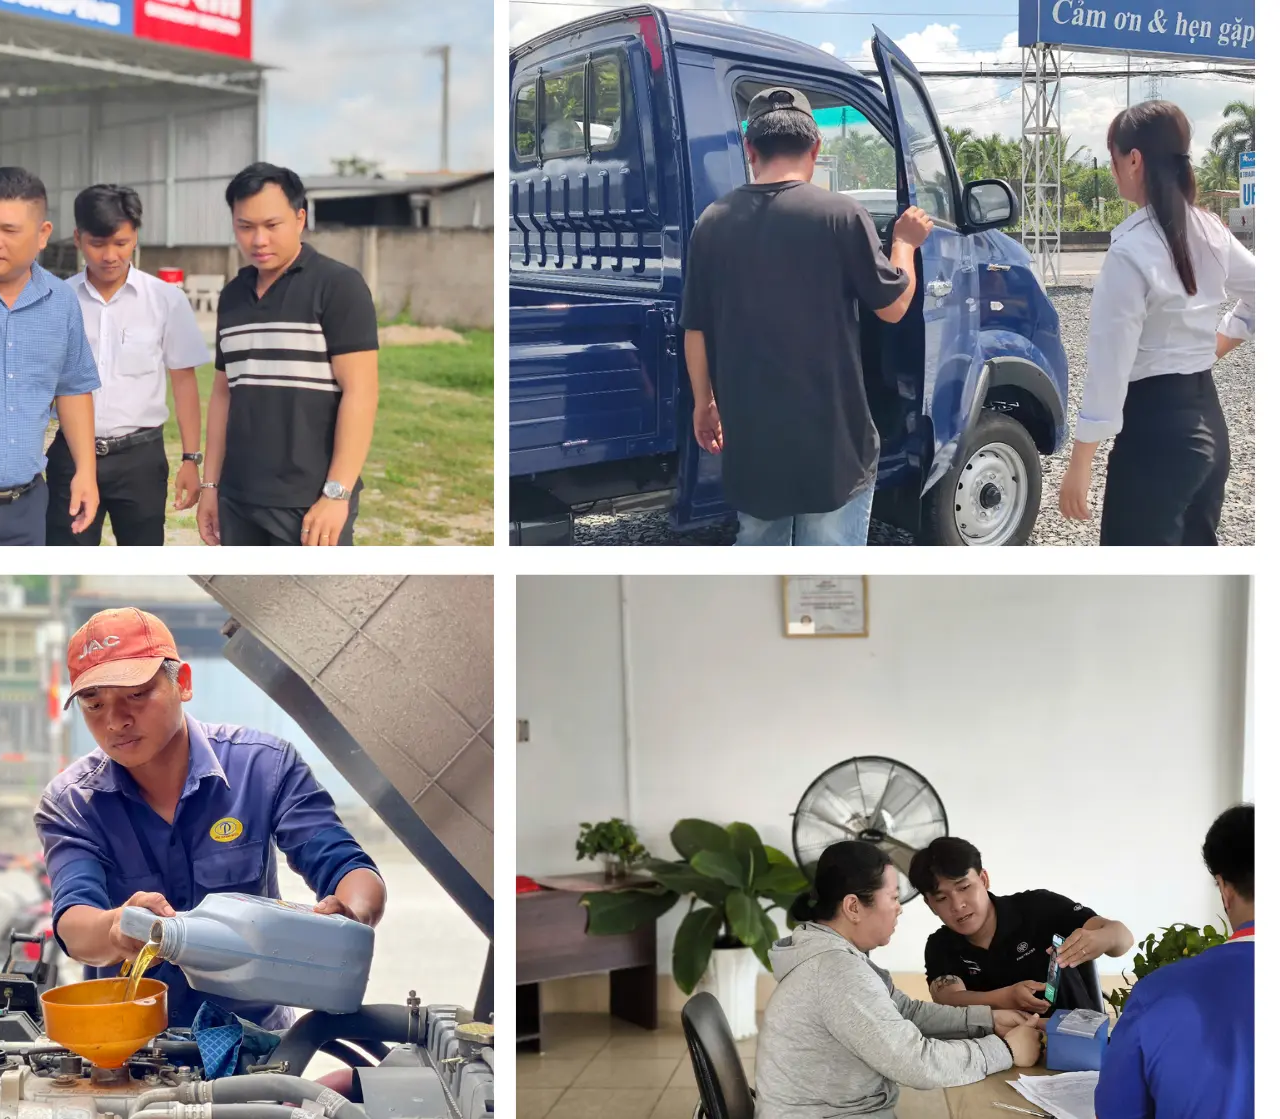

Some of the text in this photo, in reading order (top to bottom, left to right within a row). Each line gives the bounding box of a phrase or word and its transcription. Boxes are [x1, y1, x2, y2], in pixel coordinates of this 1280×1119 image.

[1051, 0, 1255, 48] Cảm ơn & hẹn gặp
[78, 635, 120, 660] JAC
